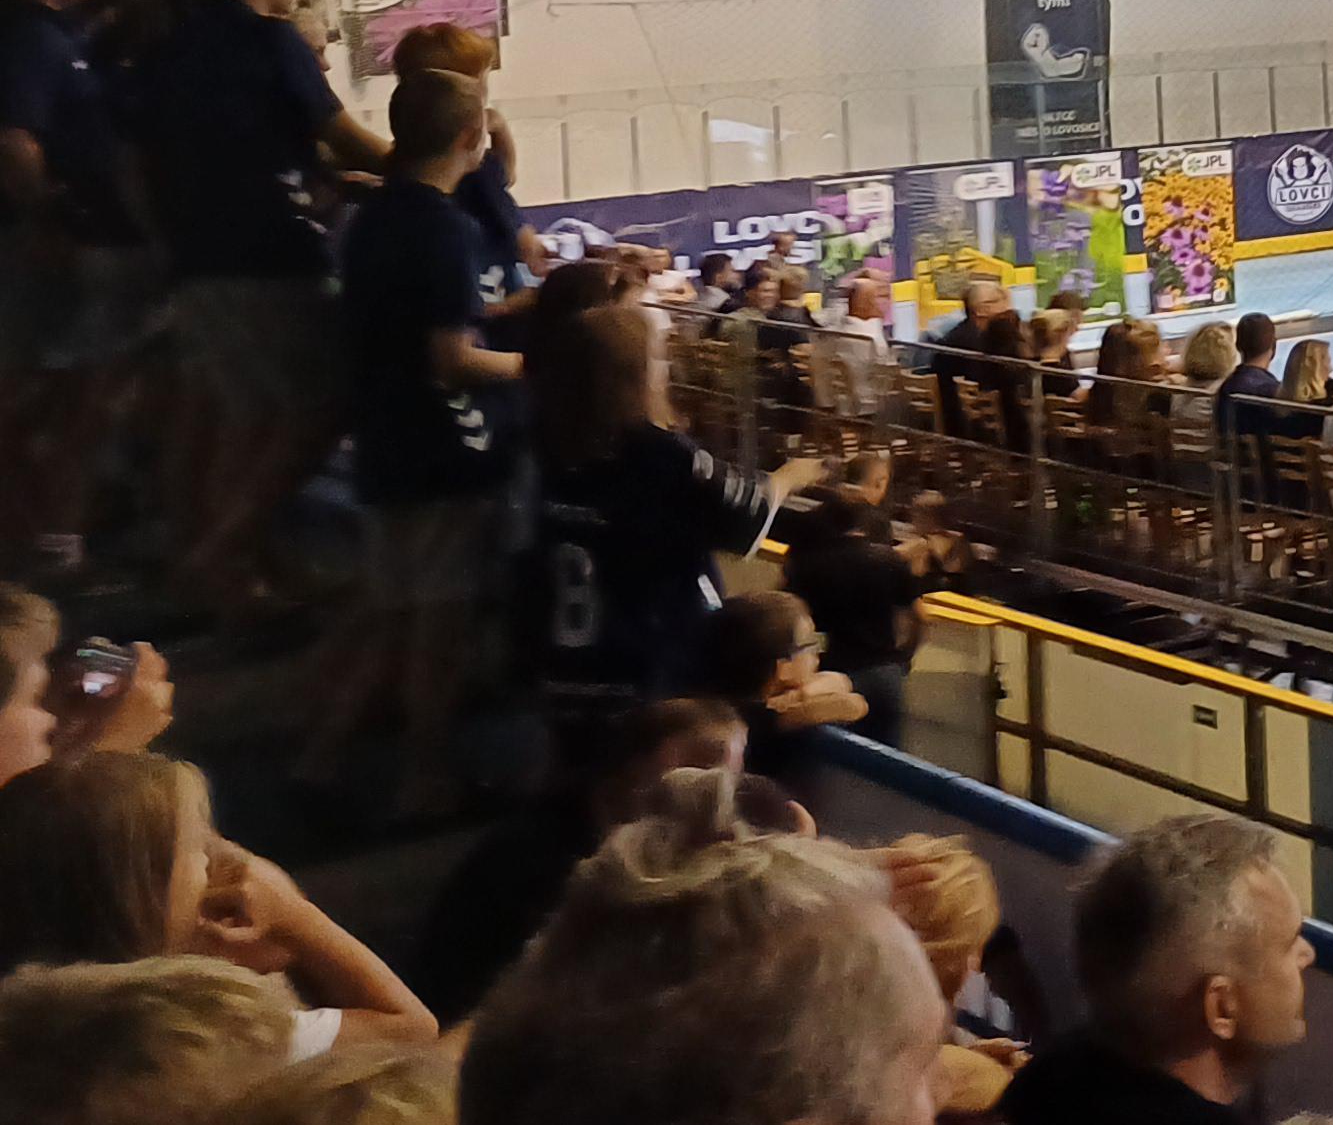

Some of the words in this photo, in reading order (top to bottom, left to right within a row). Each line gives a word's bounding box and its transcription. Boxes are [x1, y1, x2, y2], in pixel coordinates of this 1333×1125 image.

[1202, 154, 1228, 168] JPL
[1091, 165, 1117, 179] JPL
[1279, 186, 1326, 203] LOVCI
